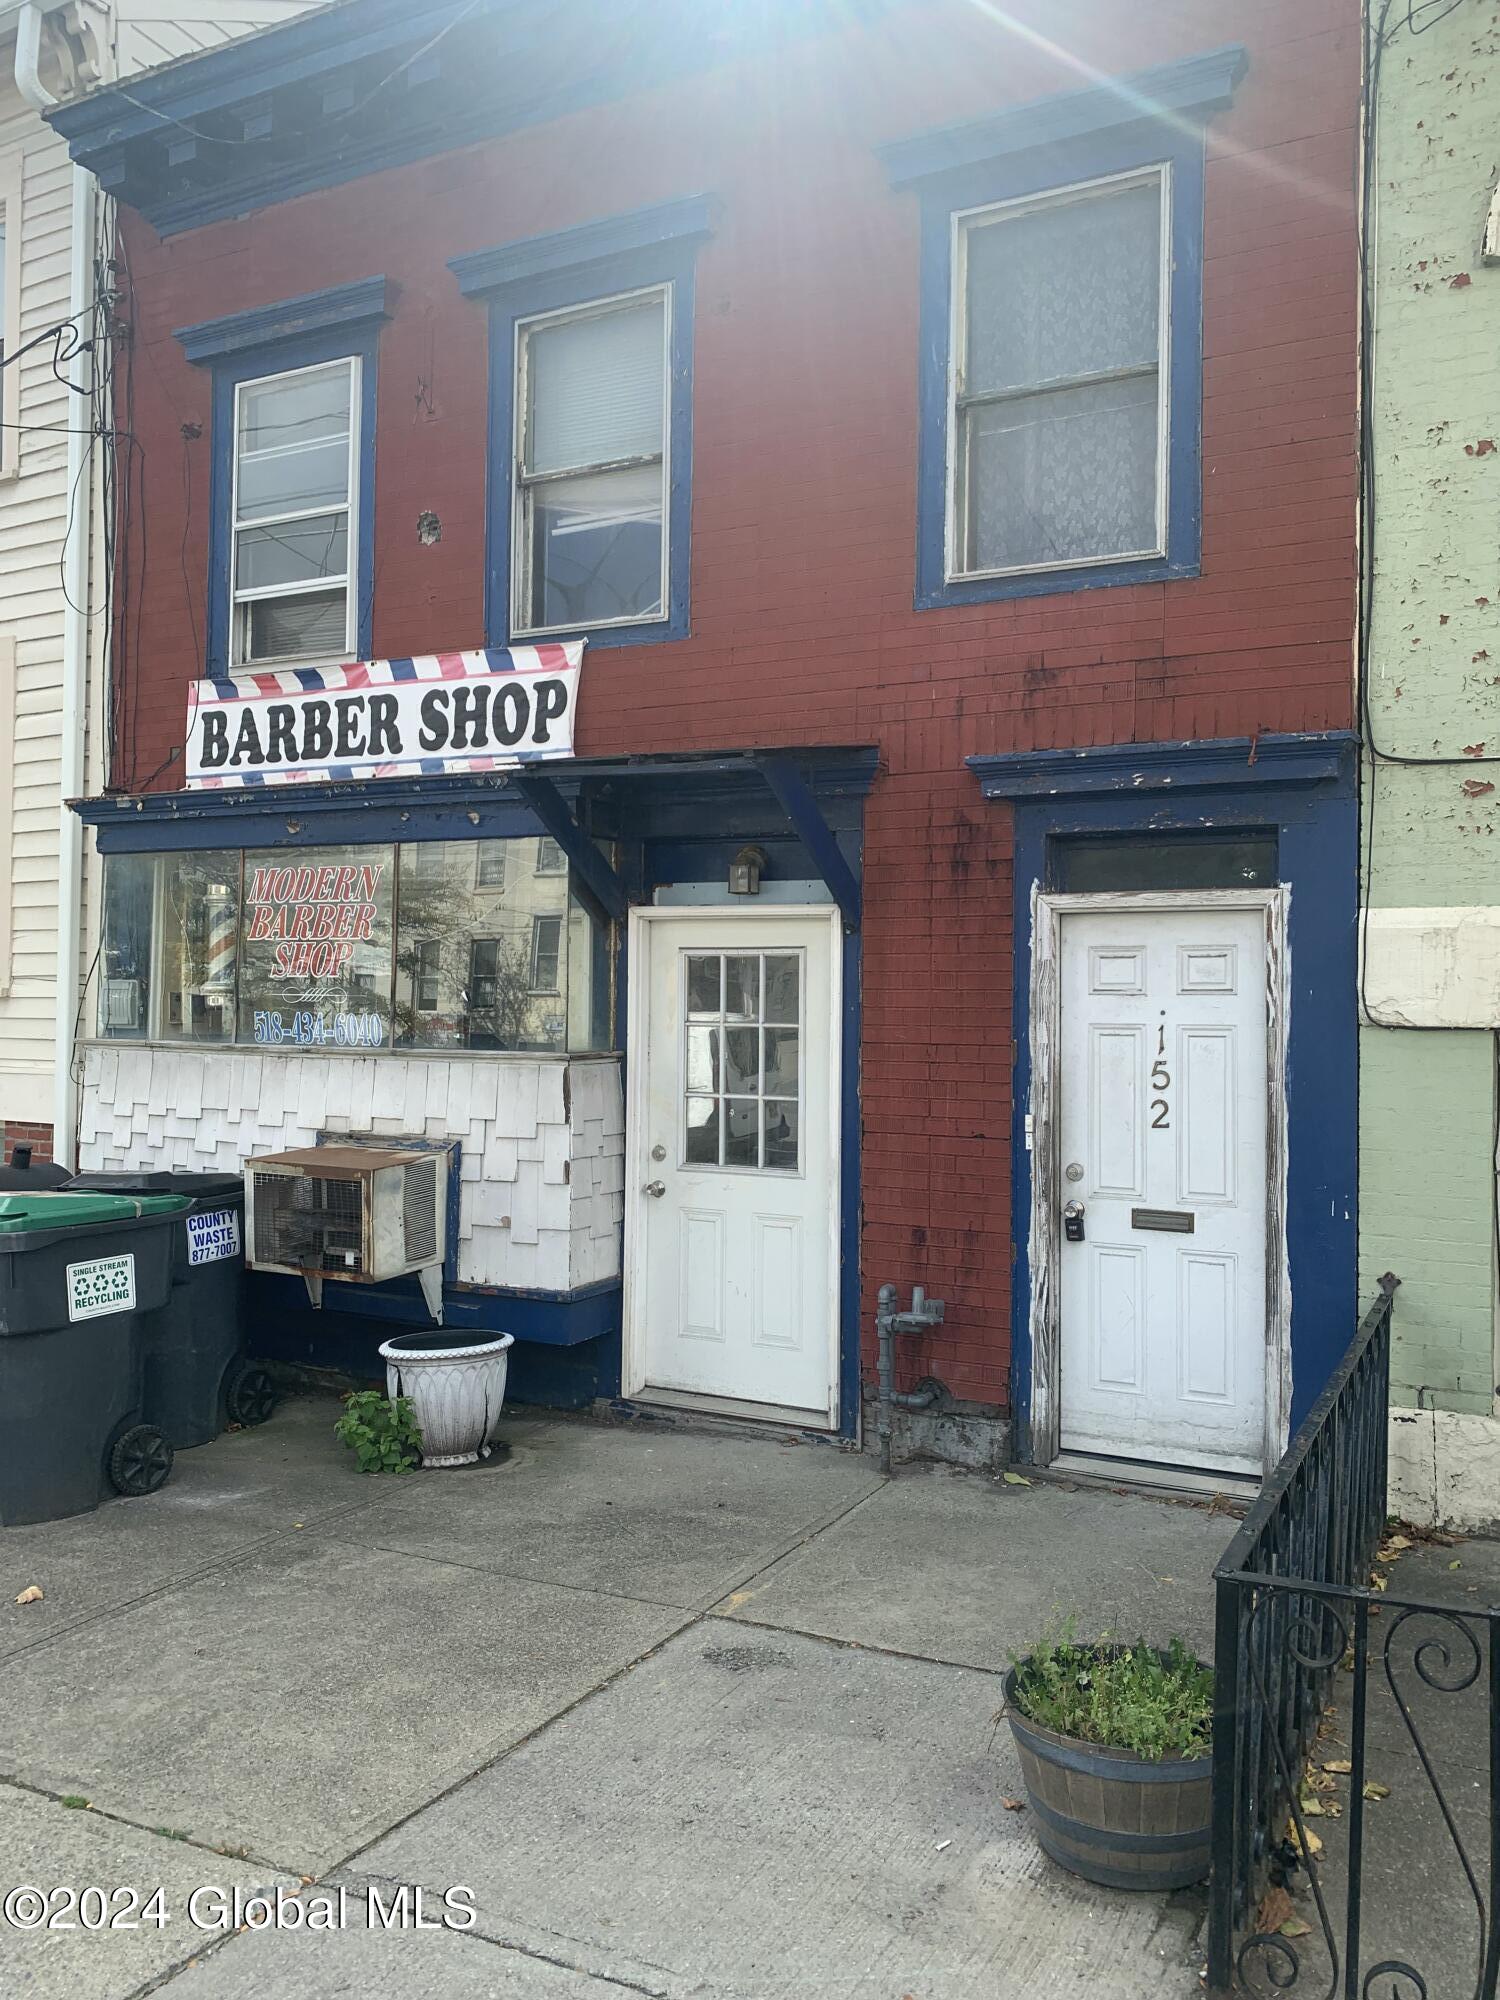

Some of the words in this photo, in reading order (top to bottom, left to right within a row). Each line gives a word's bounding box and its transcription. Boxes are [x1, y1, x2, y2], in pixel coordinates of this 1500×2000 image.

[199, 693, 404, 768] BARBER
[418, 678, 569, 752] SHOP
[246, 865, 384, 904] MODERN
[247, 903, 378, 942] BARBER
[269, 941, 354, 979] SHOP
[254, 1010, 383, 1047] 518-434-6040
[1150, 1024, 1171, 1129] 152
[188, 1210, 234, 1232] COUNTY
[193, 1227, 234, 1248] WASTE
[73, 1265, 97, 1277] SINGLE
[99, 1260, 128, 1272] STREAM
[192, 1241, 237, 1262] 877-7007
[74, 1289, 129, 1309] RECYCLING
